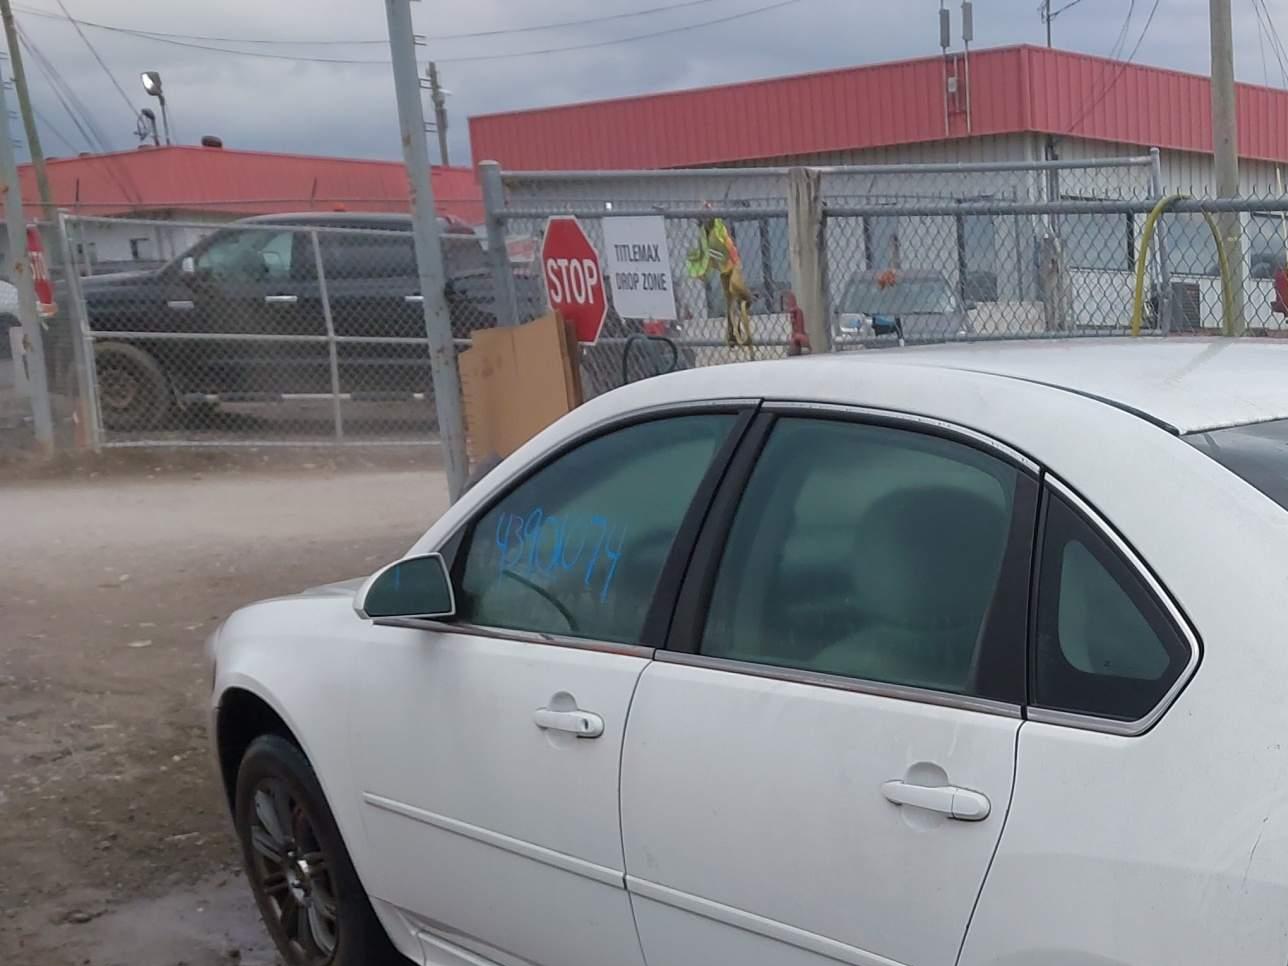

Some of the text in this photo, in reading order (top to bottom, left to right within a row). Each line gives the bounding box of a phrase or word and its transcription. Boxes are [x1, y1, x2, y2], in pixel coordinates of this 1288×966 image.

[614, 243, 661, 262] TITLEMAX
[546, 258, 598, 305] STOP
[615, 272, 668, 291] DROP ZONE
